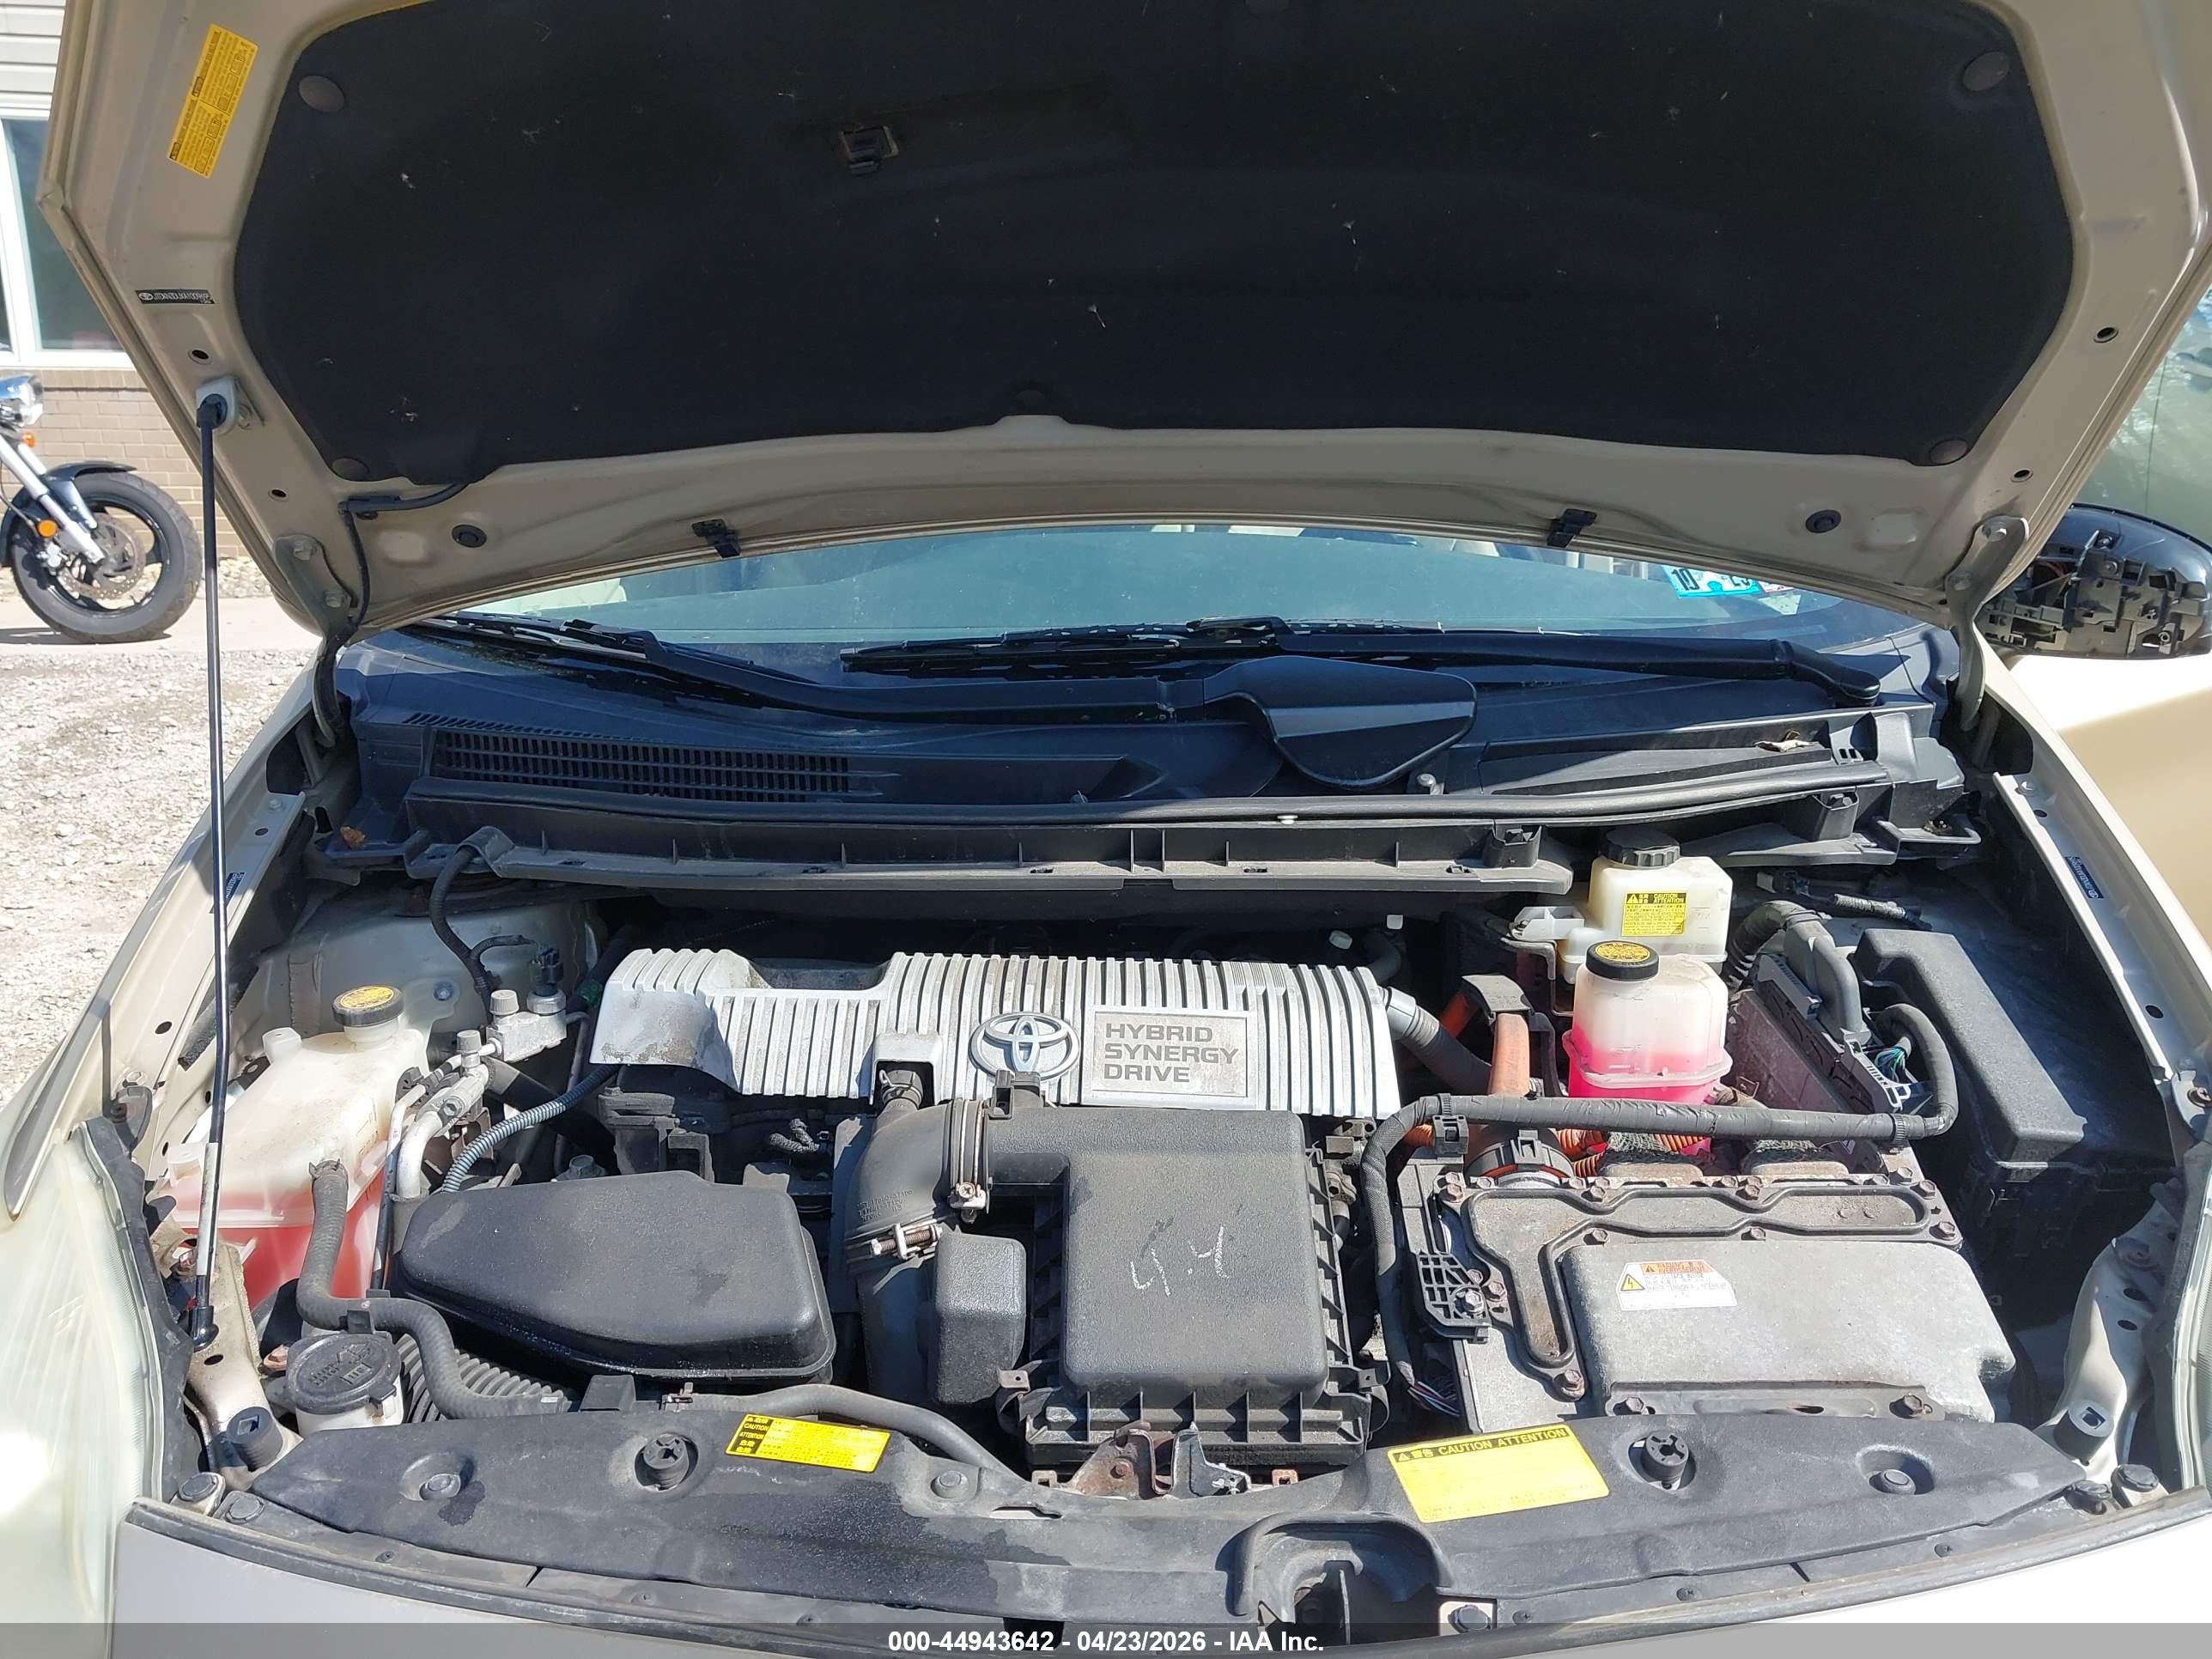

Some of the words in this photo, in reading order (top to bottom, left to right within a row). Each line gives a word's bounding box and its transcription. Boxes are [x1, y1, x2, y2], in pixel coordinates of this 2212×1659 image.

[1105, 1023, 1213, 1042] HYBRID
[1104, 1042, 1239, 1064] SYNERGY
[1103, 1064, 1190, 1083] DRIVE
[739, 1431, 765, 1440] ATTENTION
[744, 1423, 769, 1431] CAUTION
[1438, 1439, 1493, 1455] CAUTION
[1497, 1429, 1567, 1448] ATTENTION
